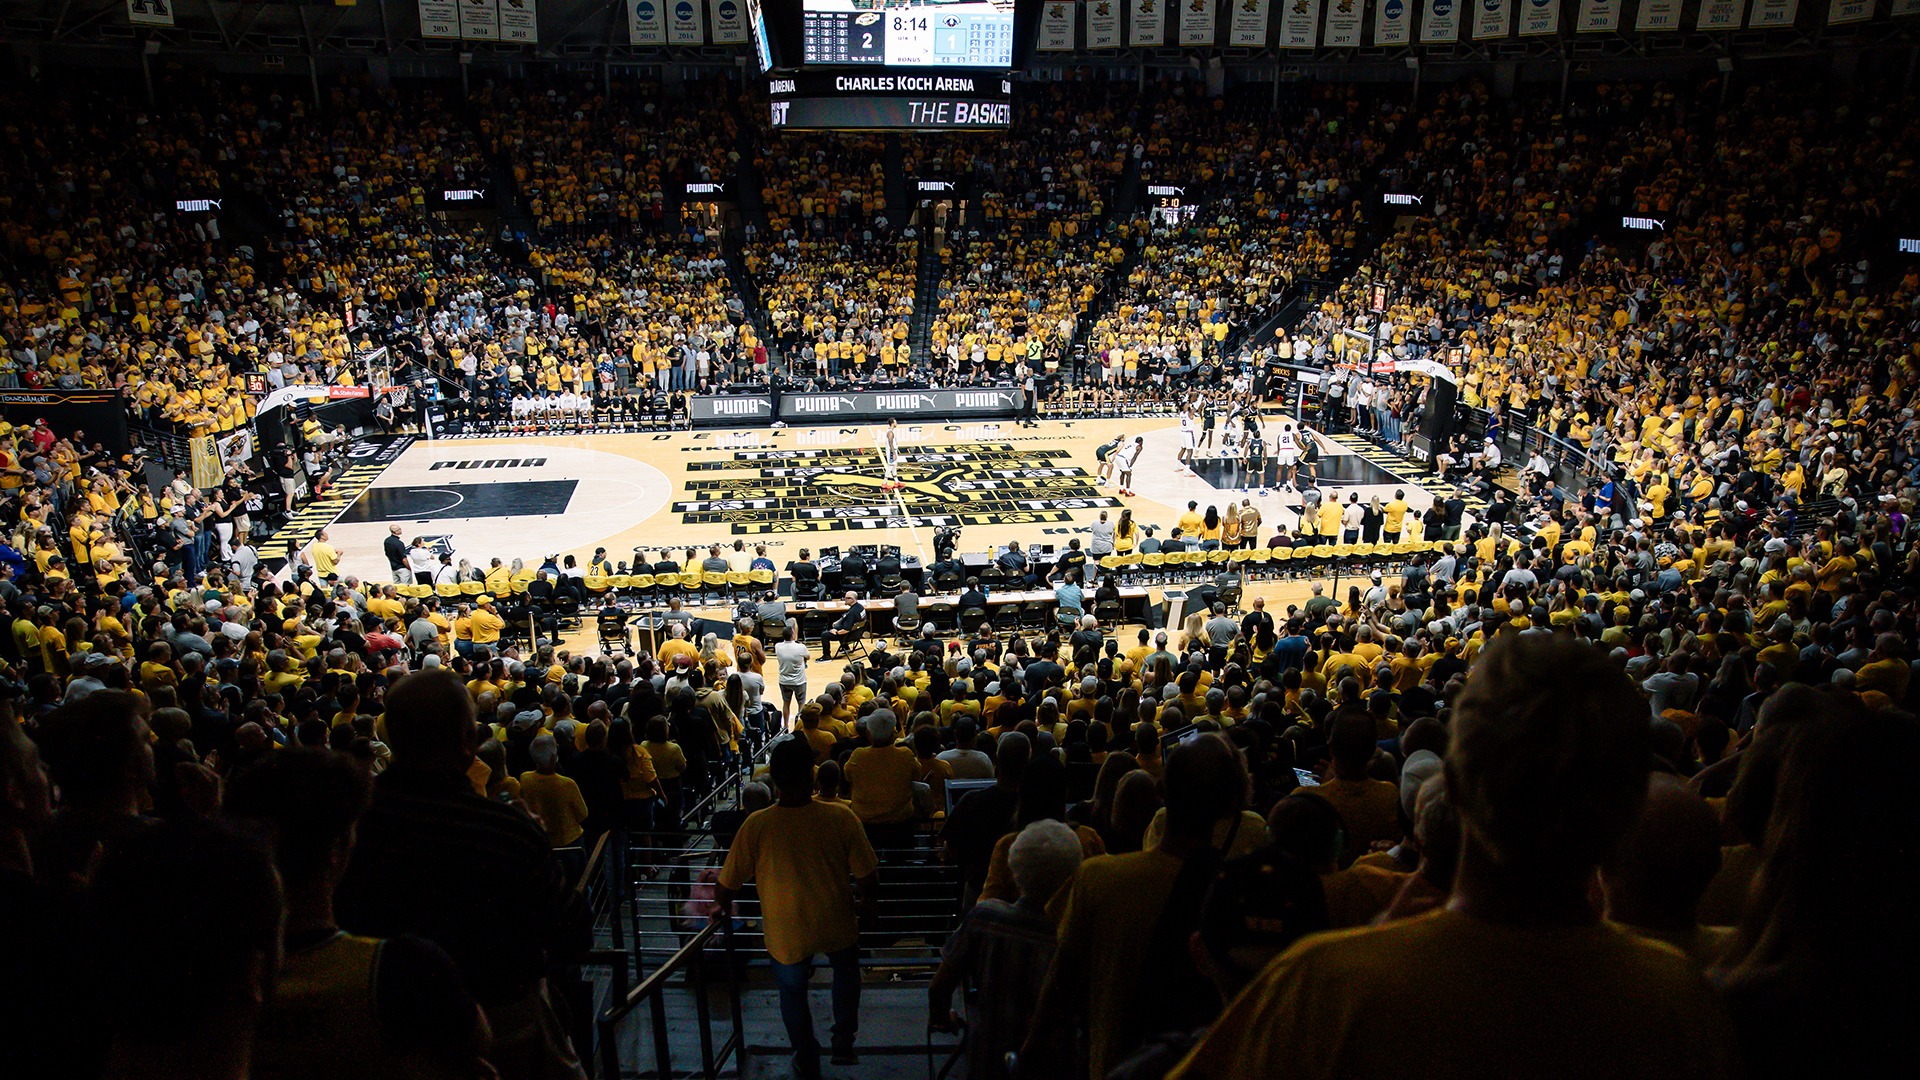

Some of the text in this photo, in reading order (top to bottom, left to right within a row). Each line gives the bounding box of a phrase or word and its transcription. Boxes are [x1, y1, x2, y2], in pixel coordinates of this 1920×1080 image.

[1589, 18, 1608, 26] 2010
[1649, 16, 1668, 24] 2011
[1710, 14, 1730, 23] 2012
[433, 25, 448, 33] 2013
[894, 17, 927, 31] 8:14
[1483, 25, 1500, 33] 2008
[1530, 21, 1548, 30] 2009
[862, 32, 873, 49] 2
[948, 34, 955, 50] 1
[836, 76, 974, 91] CHARLES KOCH ARENA
[909, 102, 949, 123] THE
[687, 183, 714, 193] PUMA
[918, 182, 945, 191] PUMA
[1148, 186, 1174, 195] PUMA
[444, 190, 473, 200] PUMA
[1384, 194, 1411, 204] PUMA
[177, 200, 209, 212] PUMA
[1161, 198, 1179, 207] 3:10
[1622, 217, 1653, 229] PUMA
[1272, 367, 1290, 377] SHOCKS
[250, 382, 262, 390] 30
[795, 397, 840, 412] PUMA
[876, 395, 920, 409] PUMA
[955, 393, 999, 407] PUMA
[713, 399, 759, 414] PUMA
[1253, 447, 1259, 455] 4
[1412, 446, 1429, 462] TBT
[429, 457, 548, 471] PUMA
[295, 482, 308, 500] TBT
[590, 565, 599, 576] 23
